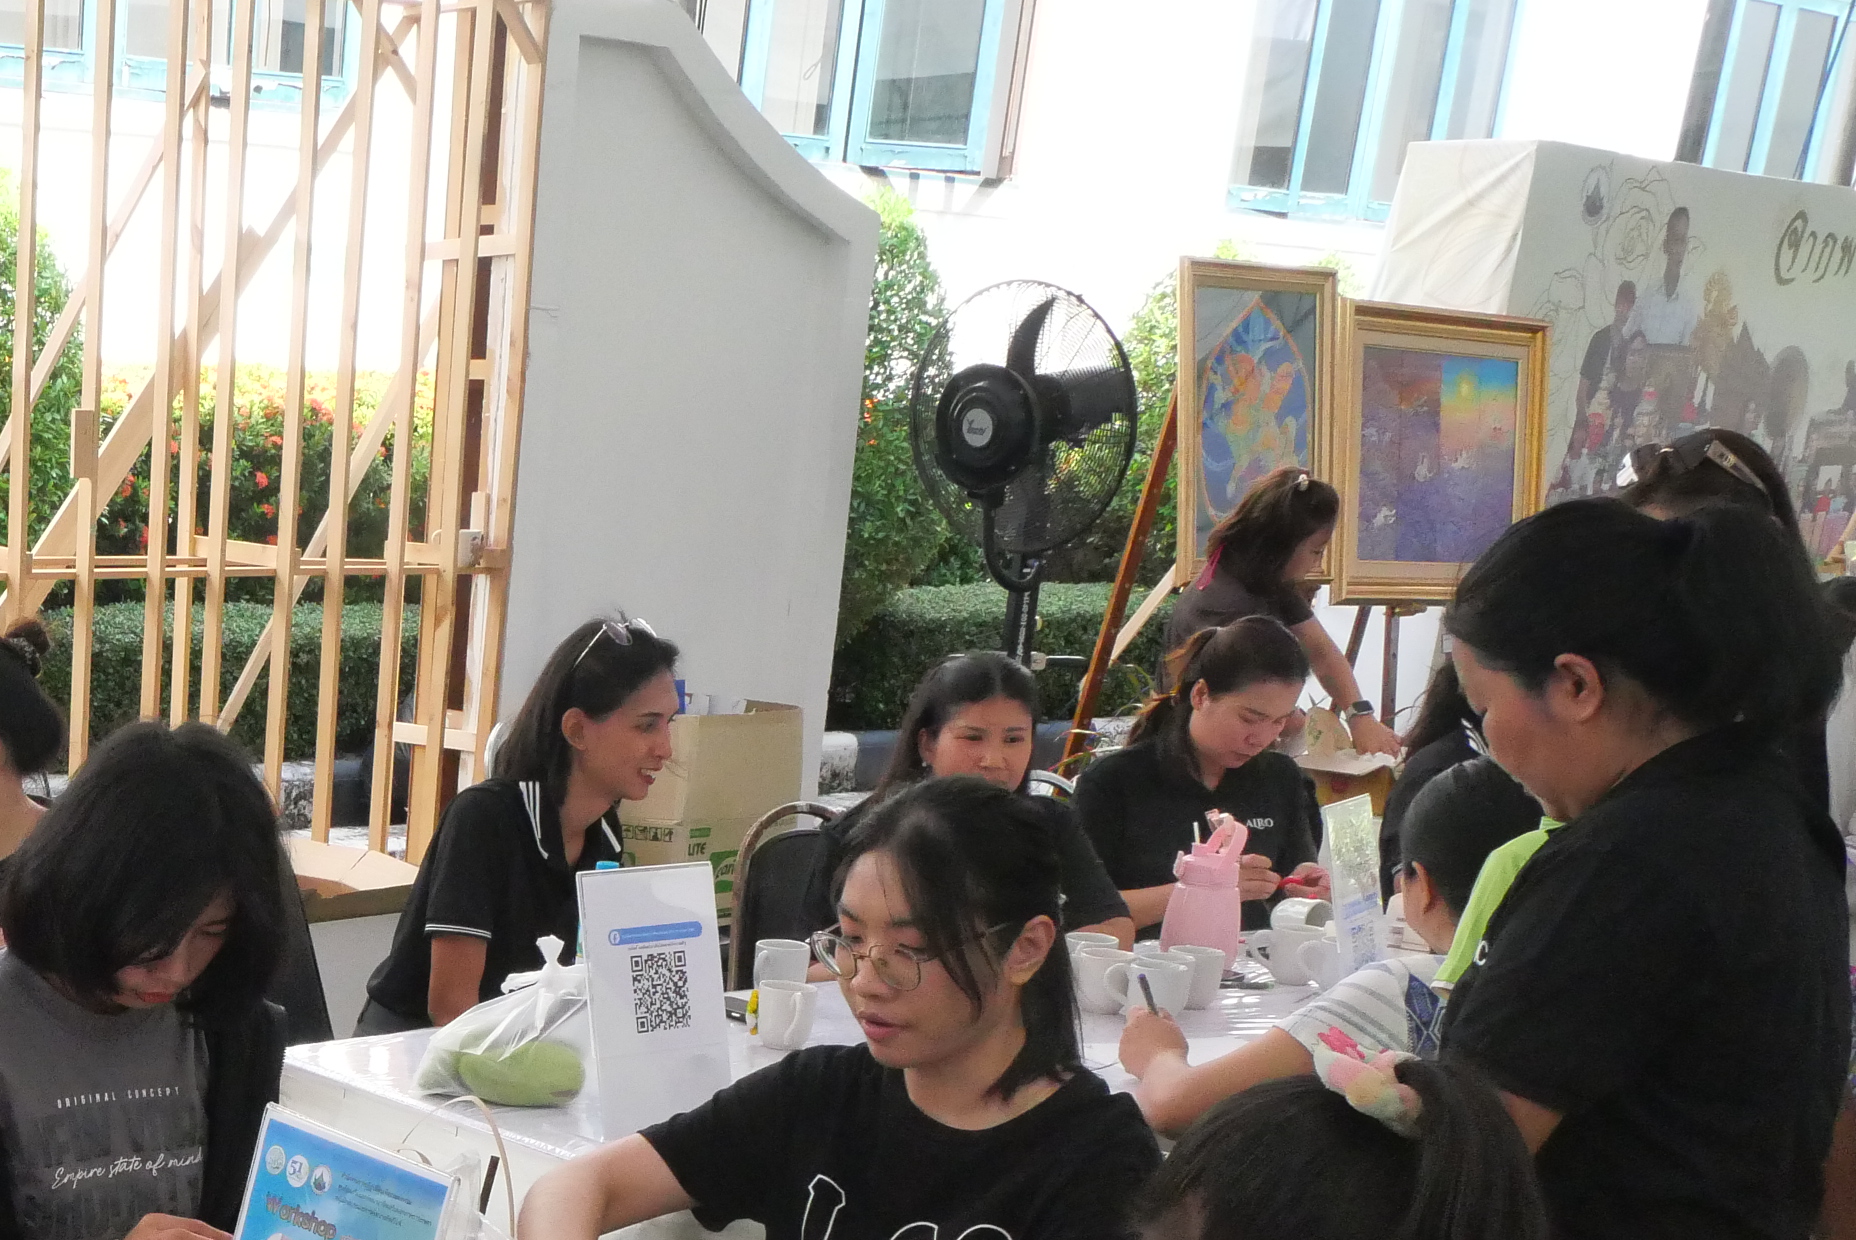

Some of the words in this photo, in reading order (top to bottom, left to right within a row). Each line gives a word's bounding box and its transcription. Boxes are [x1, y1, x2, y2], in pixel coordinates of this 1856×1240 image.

[688, 842, 707, 856] LITE
[57, 1091, 116, 1109] ORIGINAL
[127, 1086, 179, 1099] CONCEPT
[51, 1167, 106, 1190] Empire
[108, 1155, 142, 1179] state
[145, 1153, 165, 1177] of
[167, 1146, 204, 1169] mind
